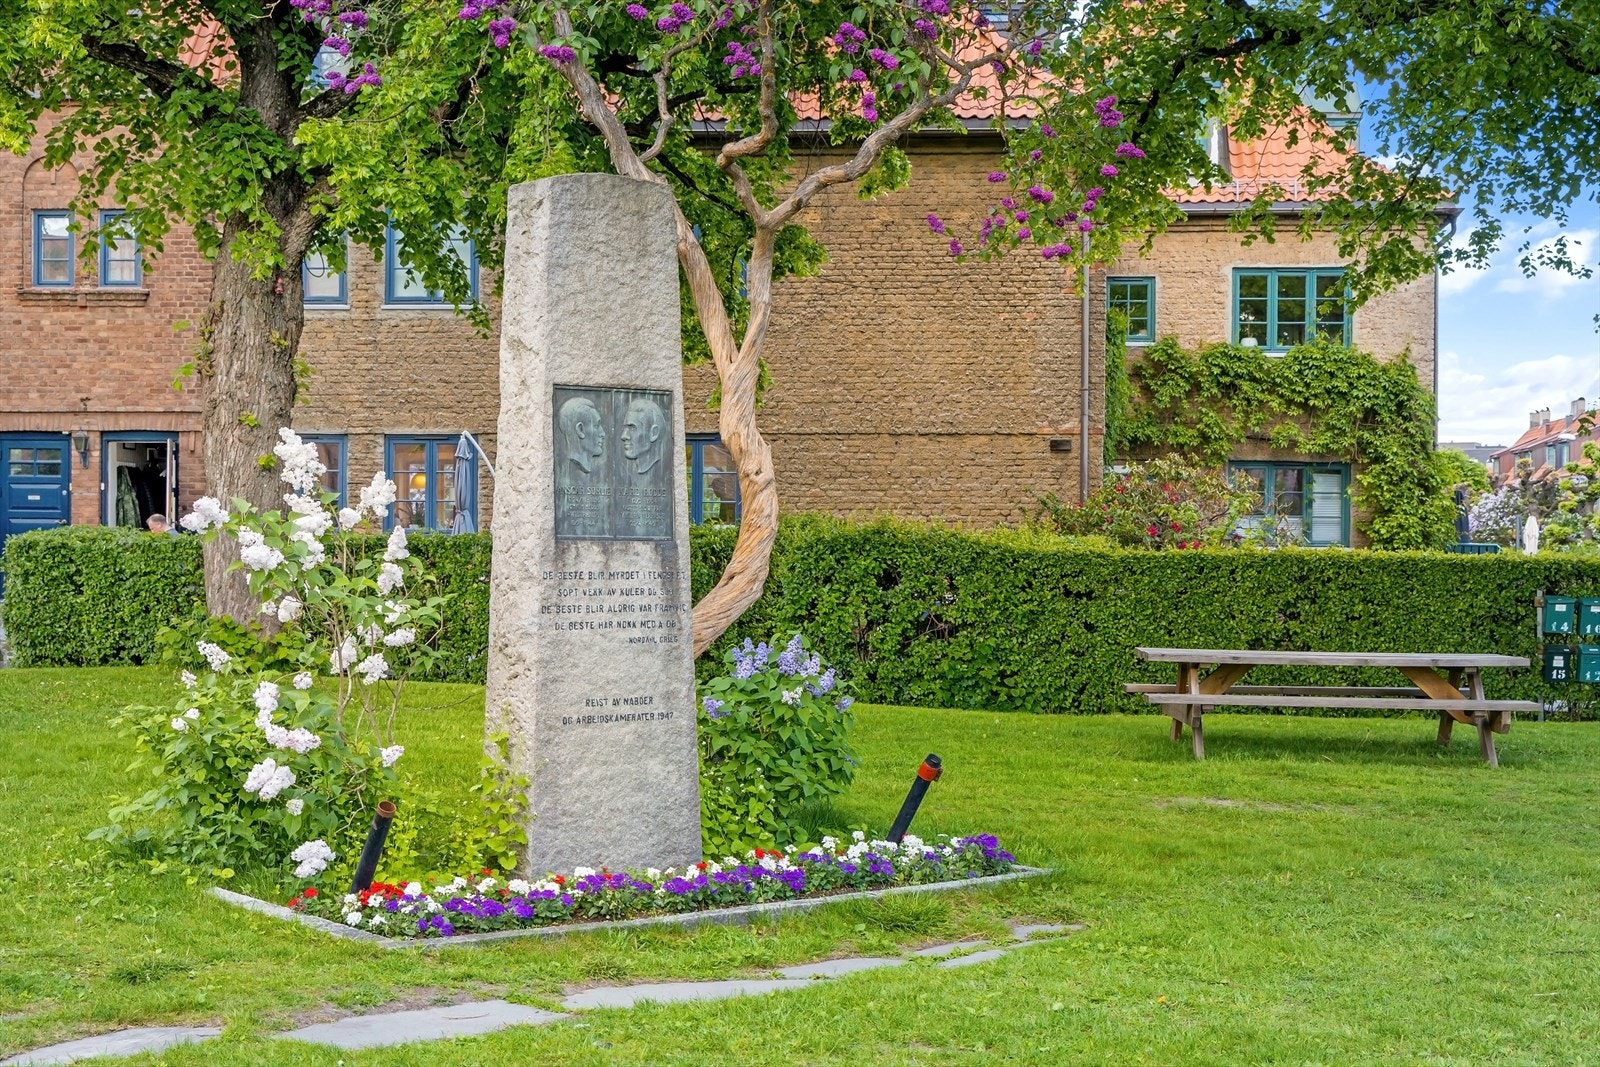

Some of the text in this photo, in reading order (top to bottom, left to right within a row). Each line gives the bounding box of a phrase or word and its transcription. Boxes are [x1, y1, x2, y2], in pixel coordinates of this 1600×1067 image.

[542, 571, 554, 580] DE
[558, 571, 583, 580] BESTE
[588, 571, 605, 580] BLIR
[608, 571, 639, 580] MYRDET
[557, 588, 578, 597] SOPT
[582, 588, 603, 597] VEKK
[607, 588, 616, 596] AV
[619, 588, 645, 597] KULER
[648, 588, 657, 596] OG
[541, 605, 552, 614] DE
[556, 605, 582, 614] BESTE
[586, 605, 604, 613] BLIR
[607, 604, 635, 613] ALDRIG
[555, 622, 565, 631] DE
[568, 621, 594, 631] BESTE
[598, 621, 613, 630] HAR
[616, 620, 636, 629] NOKK
[640, 620, 656, 629] MED
[1551, 621, 1569, 632] 14
[659, 635, 678, 643] GRIEG
[1551, 669, 1566, 679] 15
[585, 696, 653, 707] REIST AV NABOER
[562, 712, 674, 725] OG ARBEIDSKAMERATER 1947
